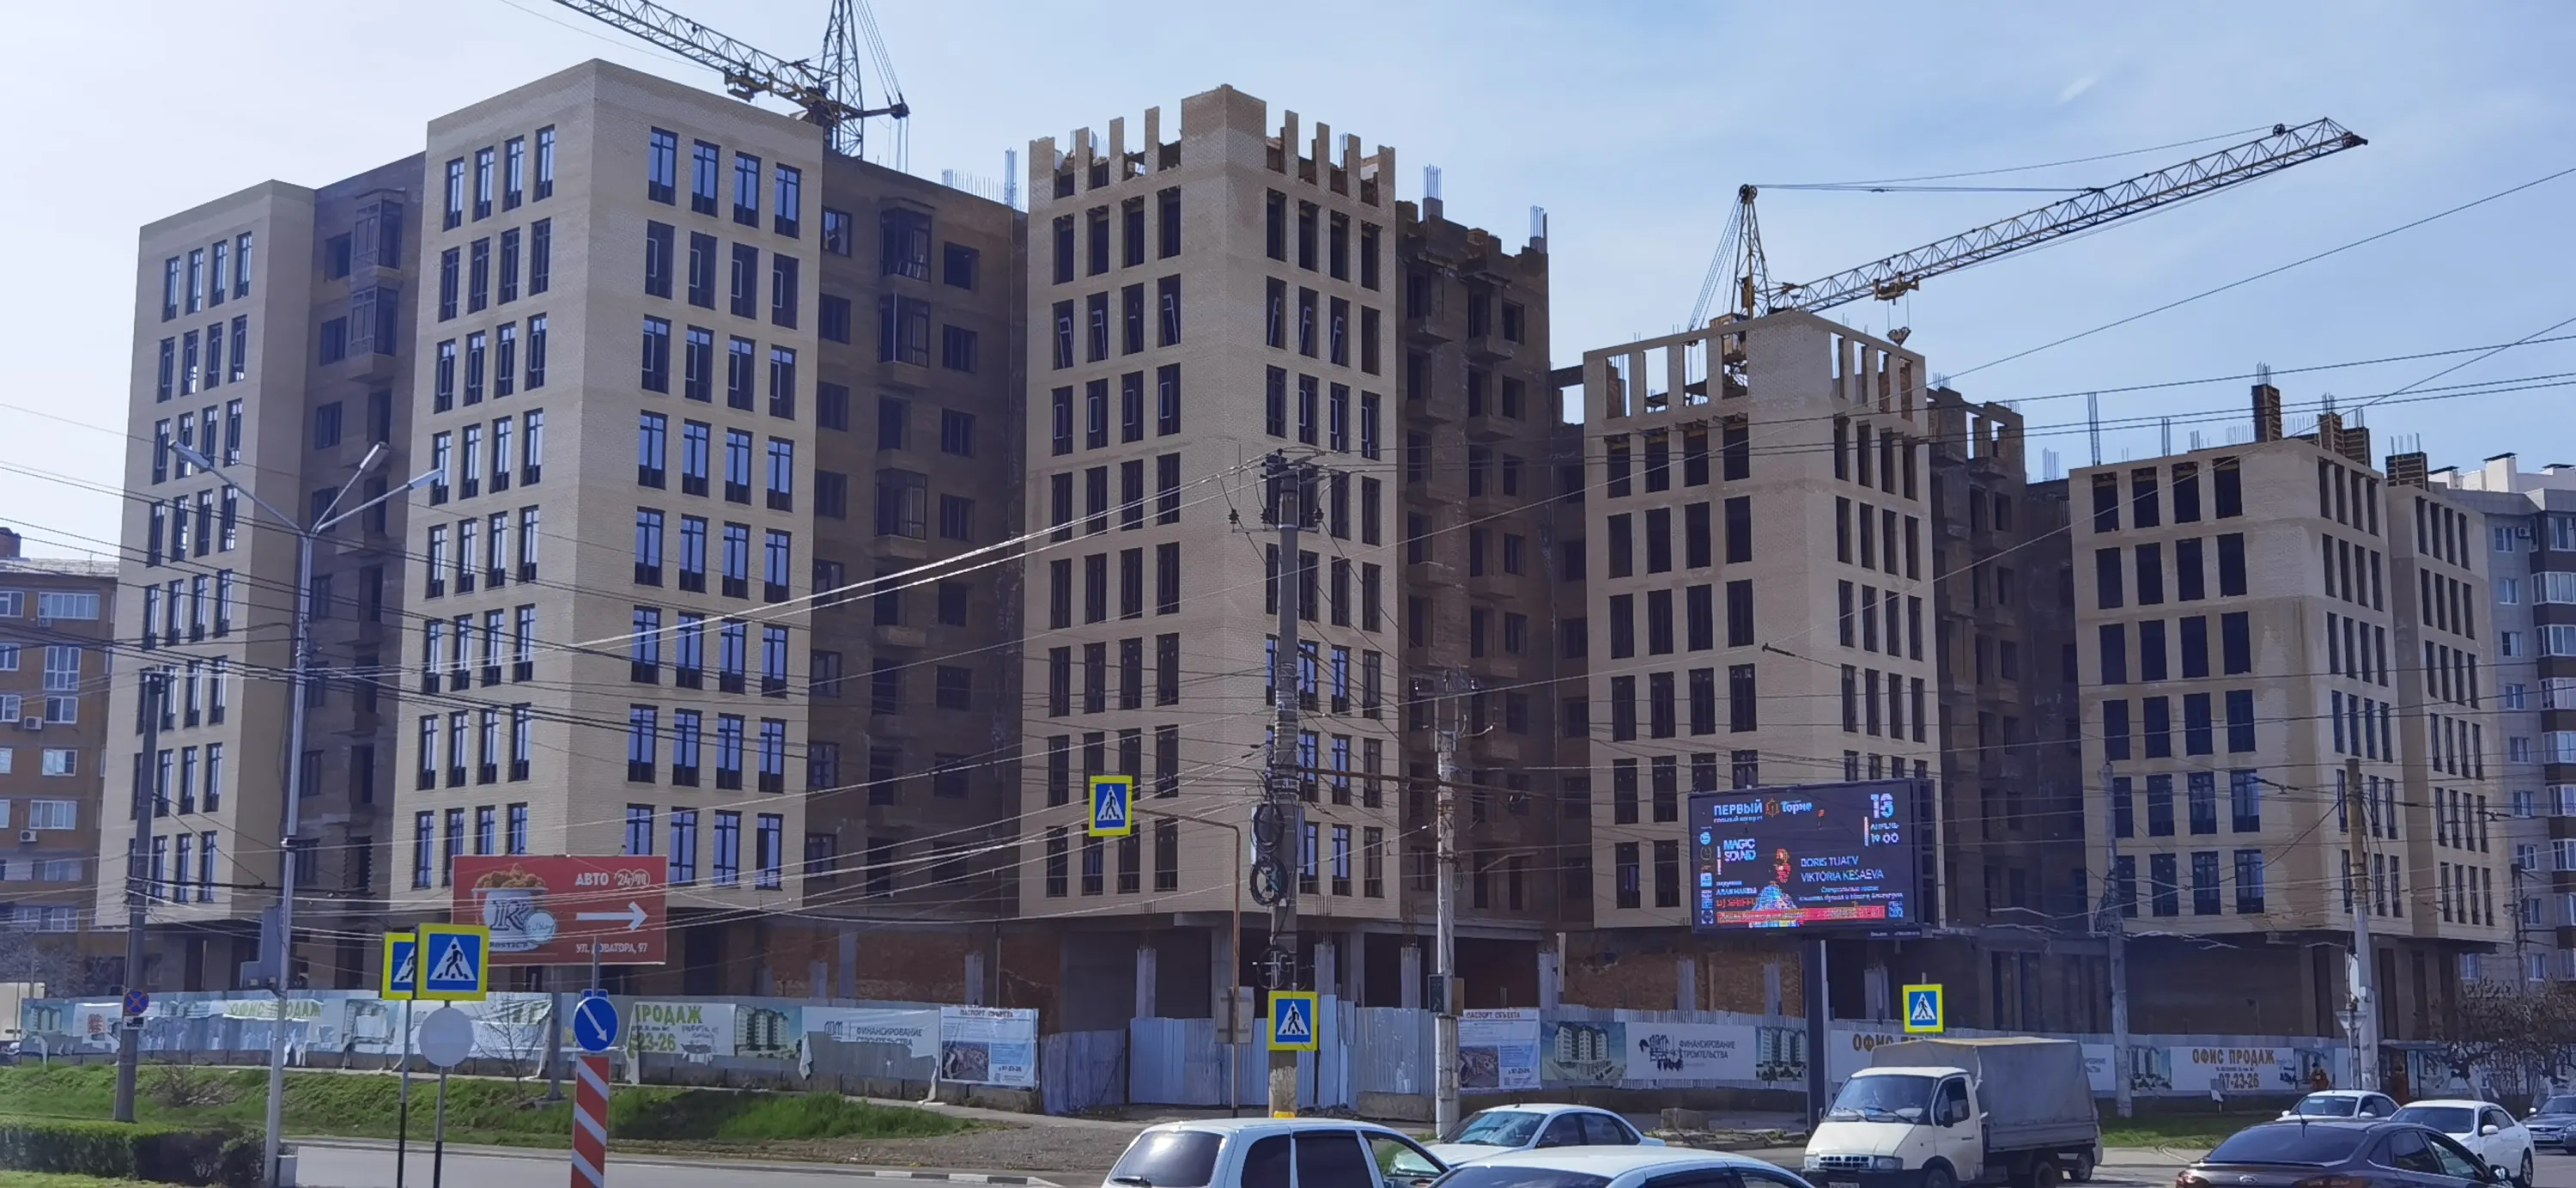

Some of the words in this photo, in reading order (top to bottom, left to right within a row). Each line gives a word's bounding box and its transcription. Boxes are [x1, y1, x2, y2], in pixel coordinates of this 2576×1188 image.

[1713, 799, 1763, 816] ПЕРВЫЙ
[1723, 838, 1755, 850] MAGIC
[1724, 850, 1757, 862] SOUND
[574, 872, 610, 886] АВТО
[1801, 870, 1842, 882] VIKTORIA
[1843, 868, 1885, 880] KESAEVA
[856, 1027, 924, 1038] ФИНАНСИРОВАНИЕ
[1680, 1039, 1736, 1050] ФИНАНСИРОВАНИЕ
[2192, 1048, 2224, 1064] ОФИС
[2228, 1049, 2276, 1067] ПРОДАЖ
